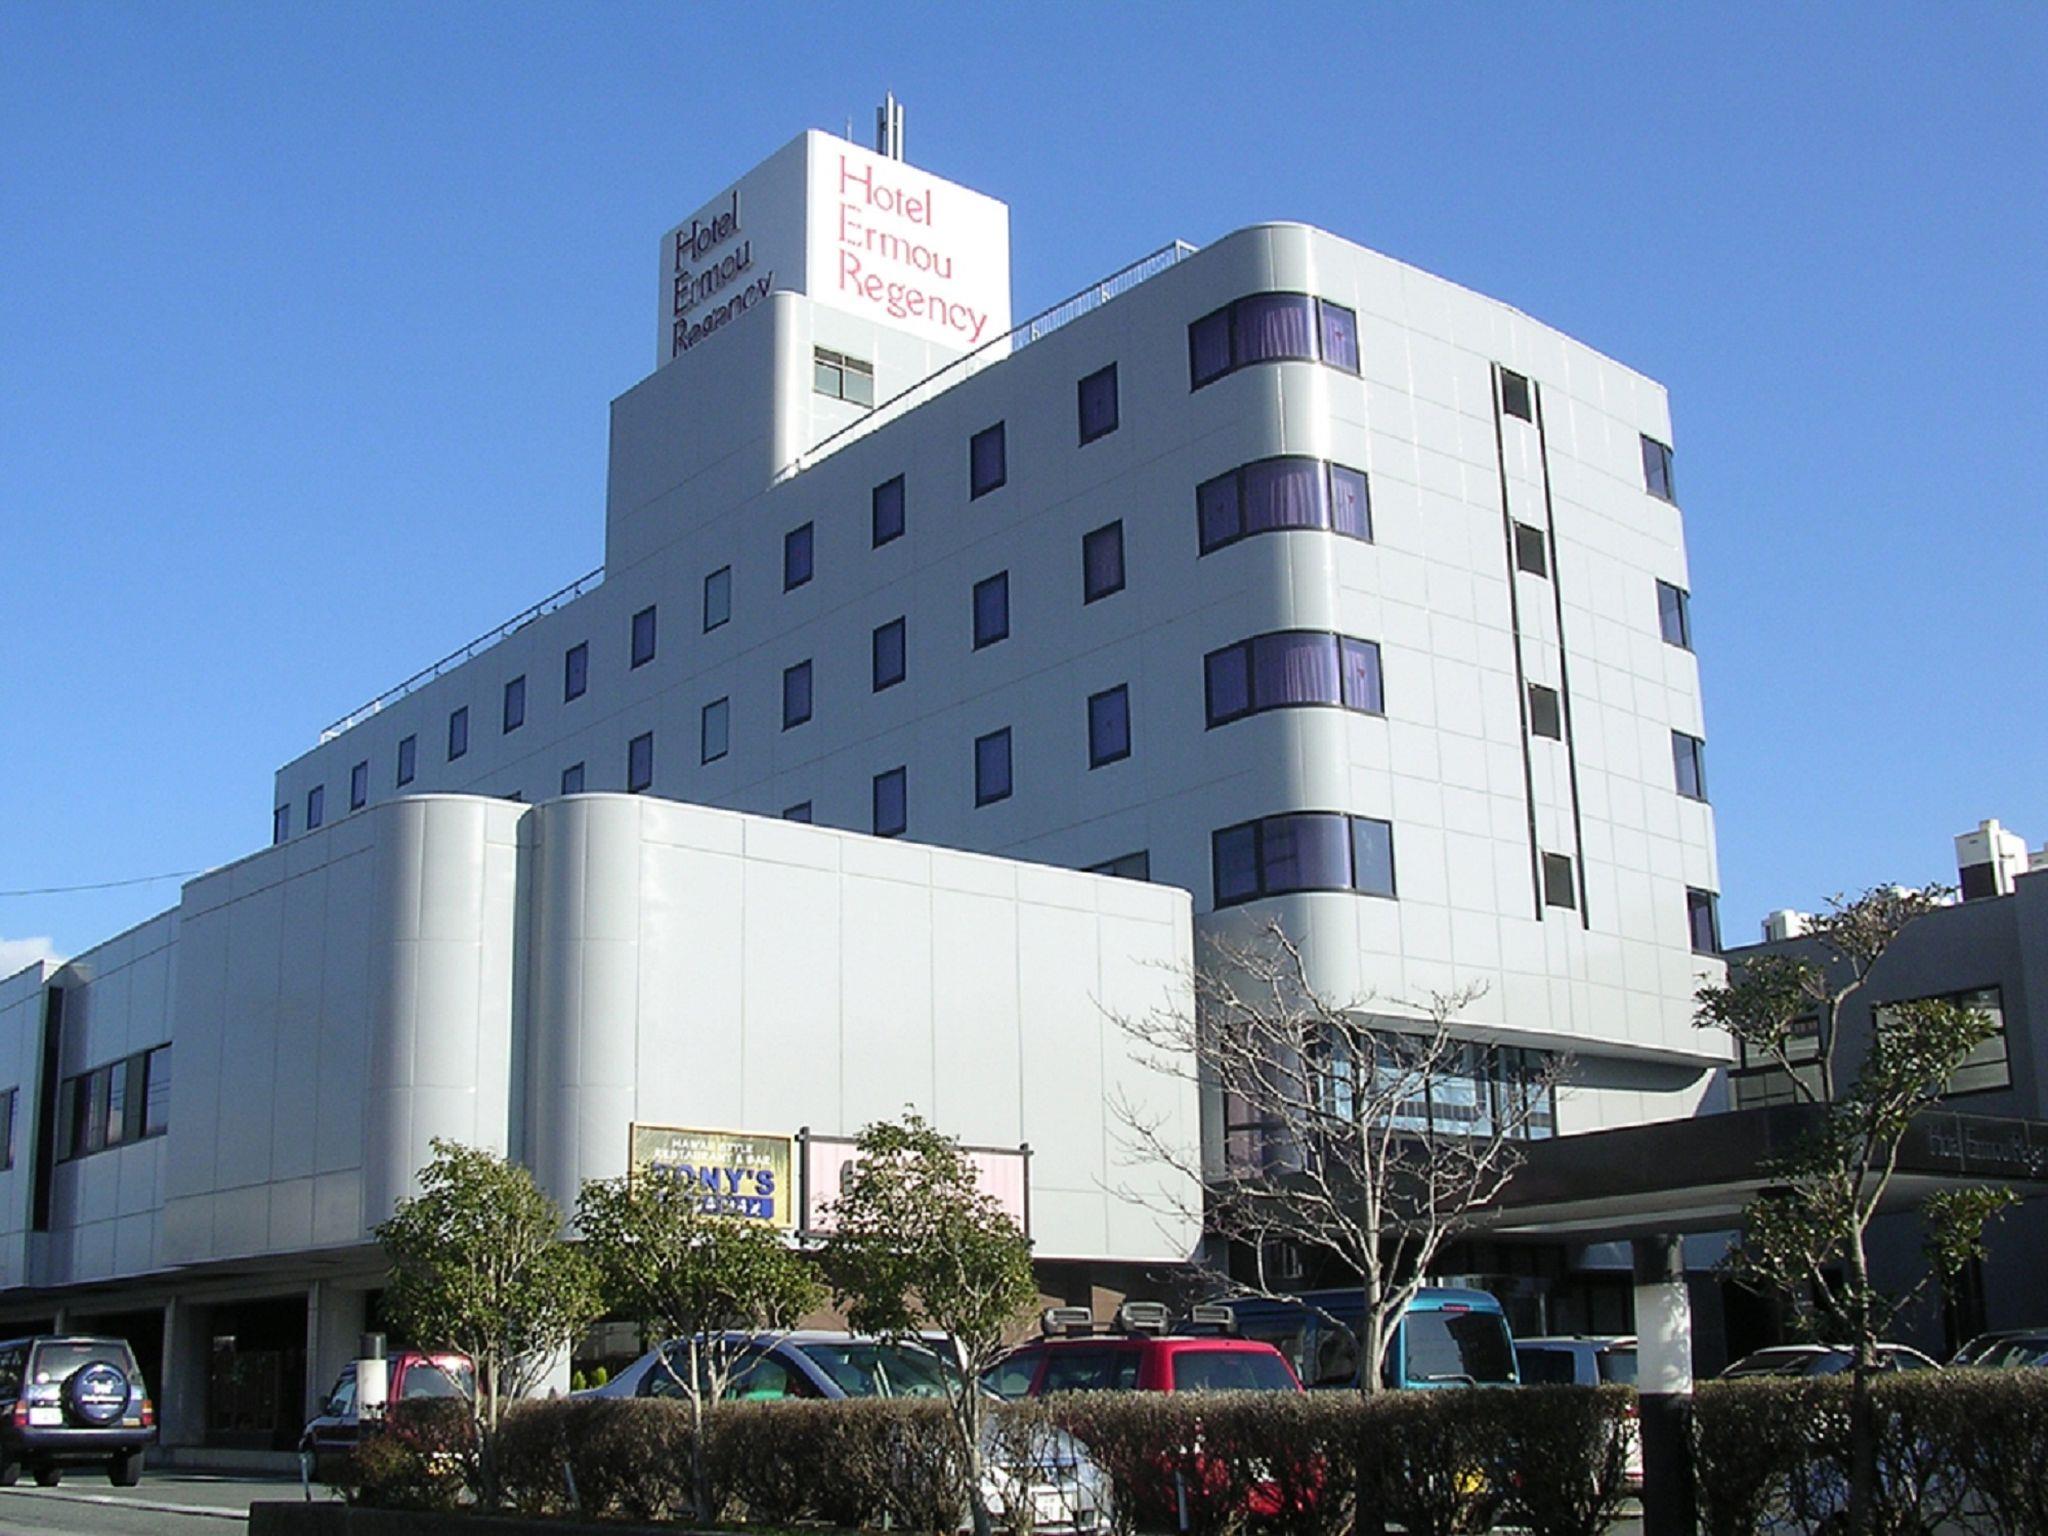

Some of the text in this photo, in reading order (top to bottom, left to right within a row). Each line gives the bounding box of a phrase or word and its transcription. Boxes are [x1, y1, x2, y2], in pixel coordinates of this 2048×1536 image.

[839, 154, 931, 226] Hotel
[674, 190, 739, 272] Hotel
[839, 202, 951, 279] Ermou
[673, 240, 752, 317] Ermou
[838, 248, 988, 343] Regency
